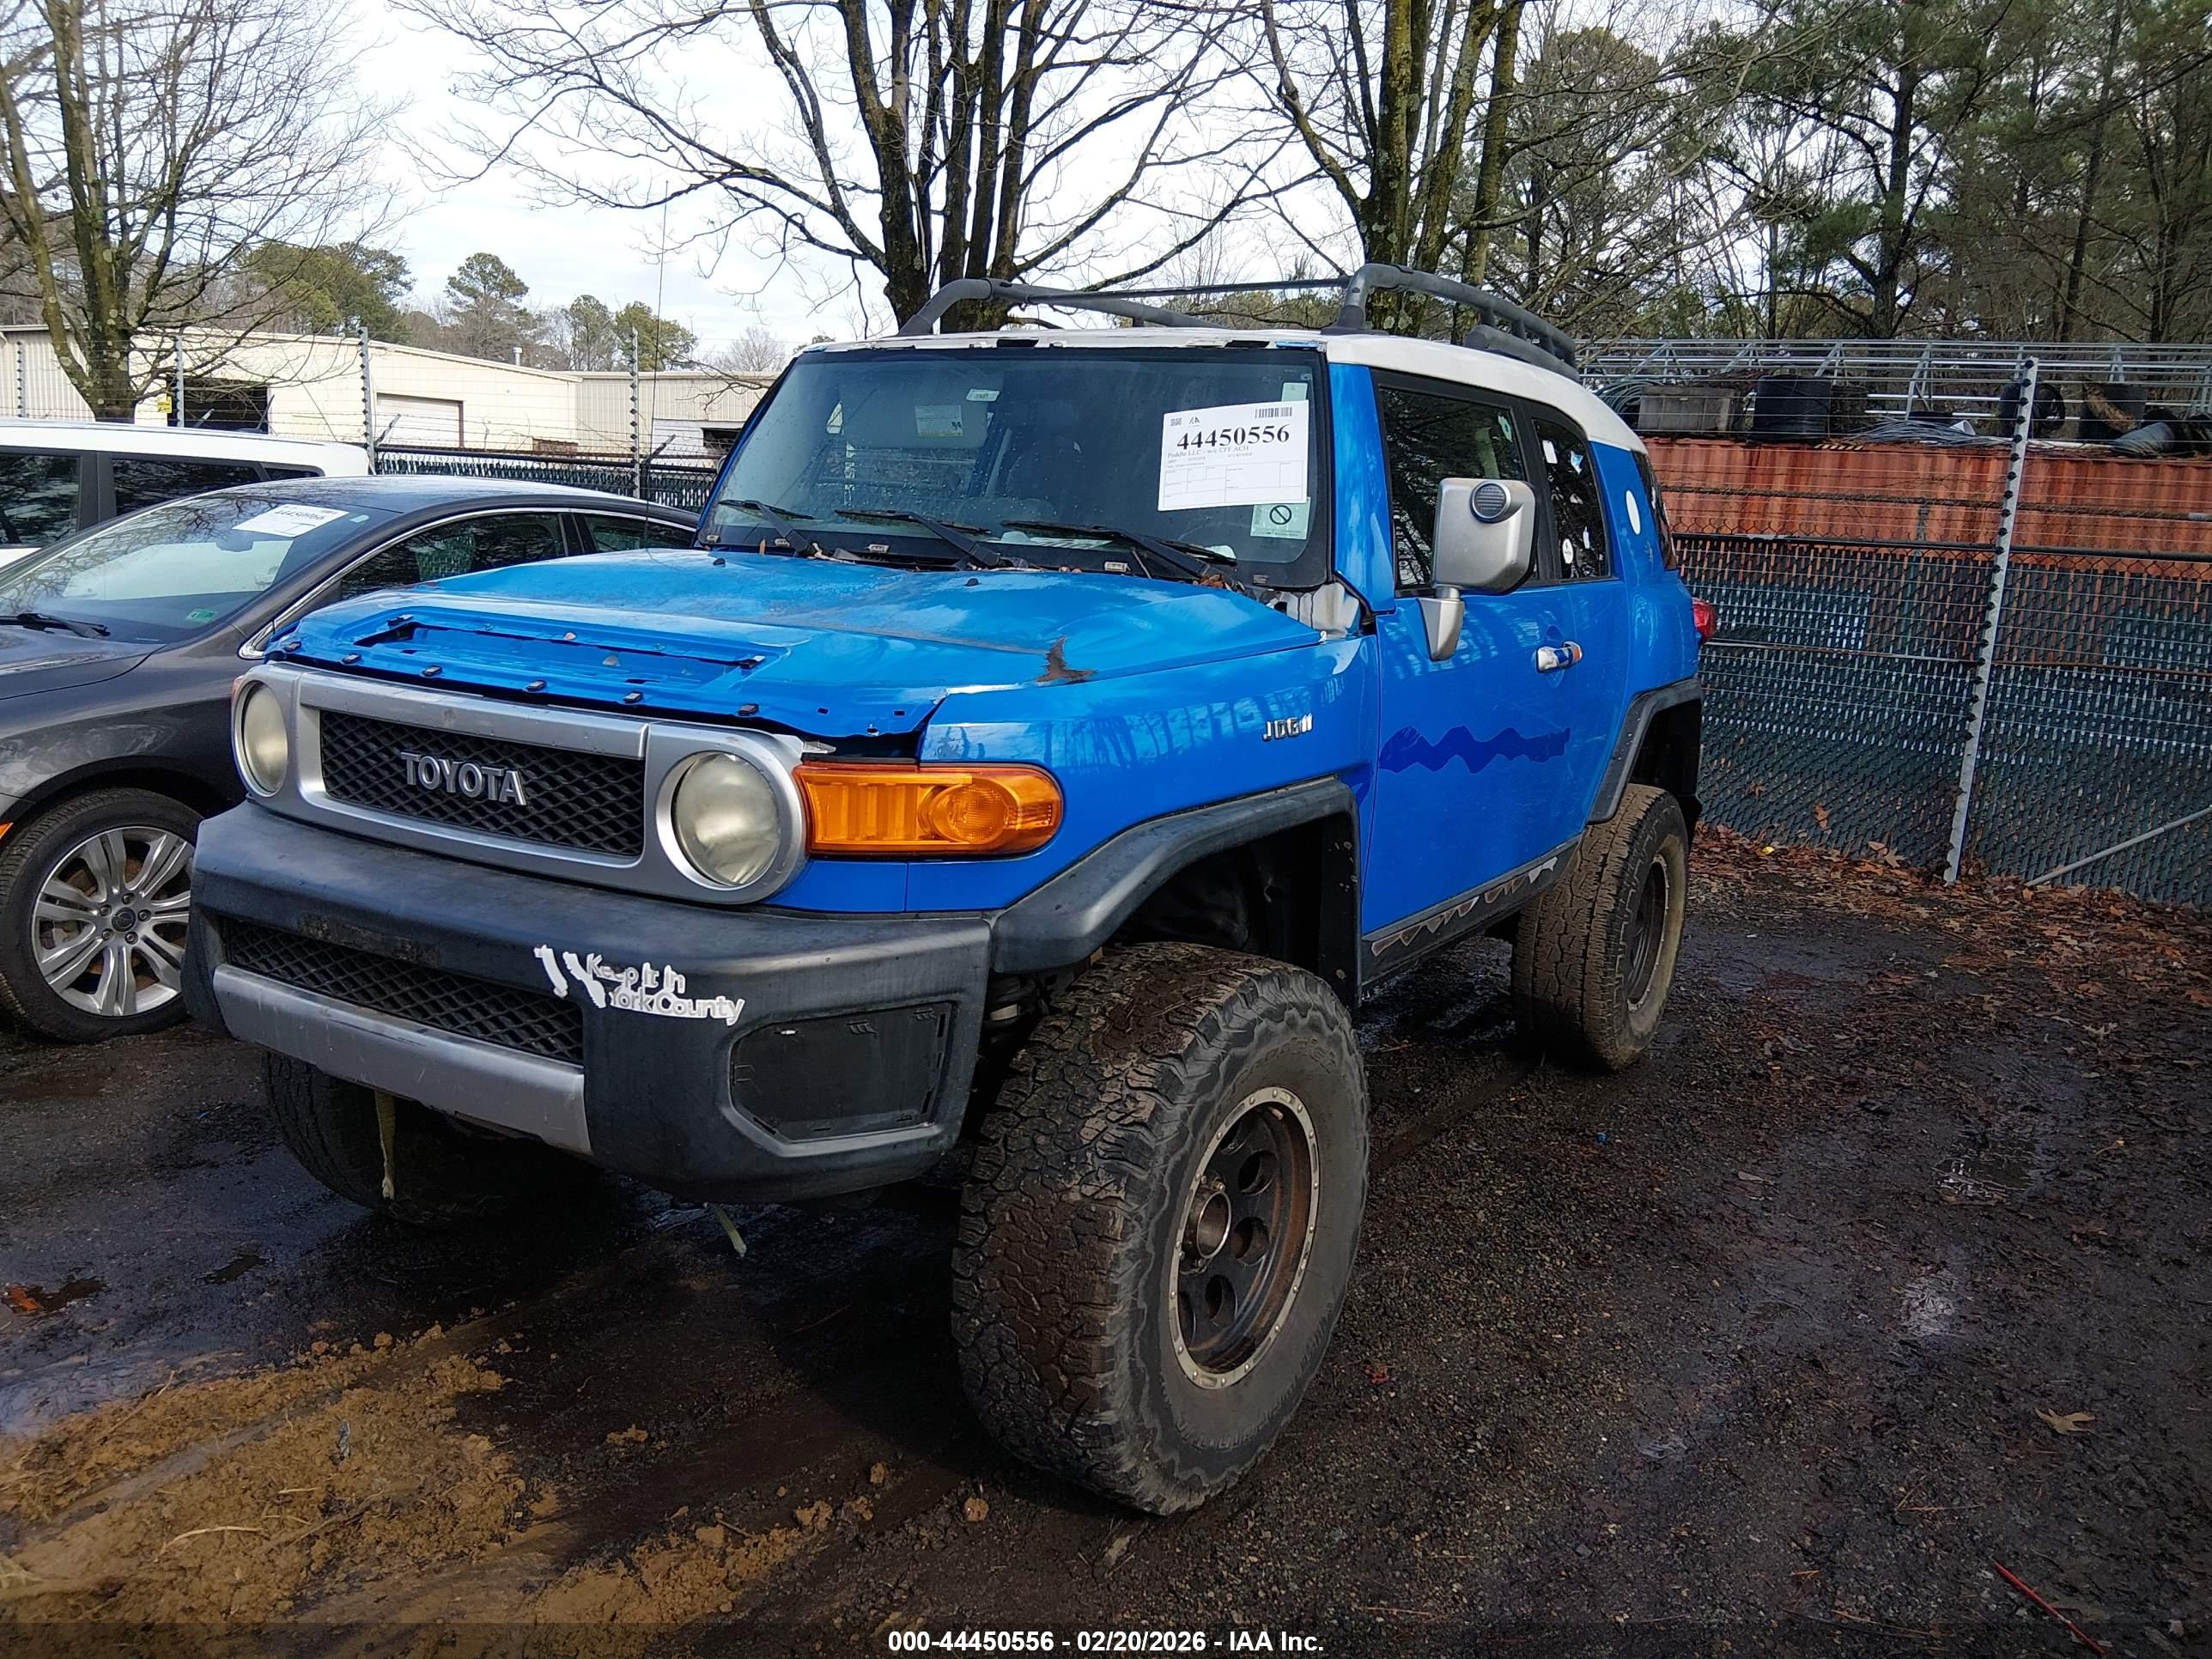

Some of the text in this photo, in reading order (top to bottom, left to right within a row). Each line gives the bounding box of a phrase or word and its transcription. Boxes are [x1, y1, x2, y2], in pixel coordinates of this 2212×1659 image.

[1176, 424, 1291, 450] 44450556
[400, 751, 527, 806] TOYOTA
[611, 986, 745, 1026] York County
